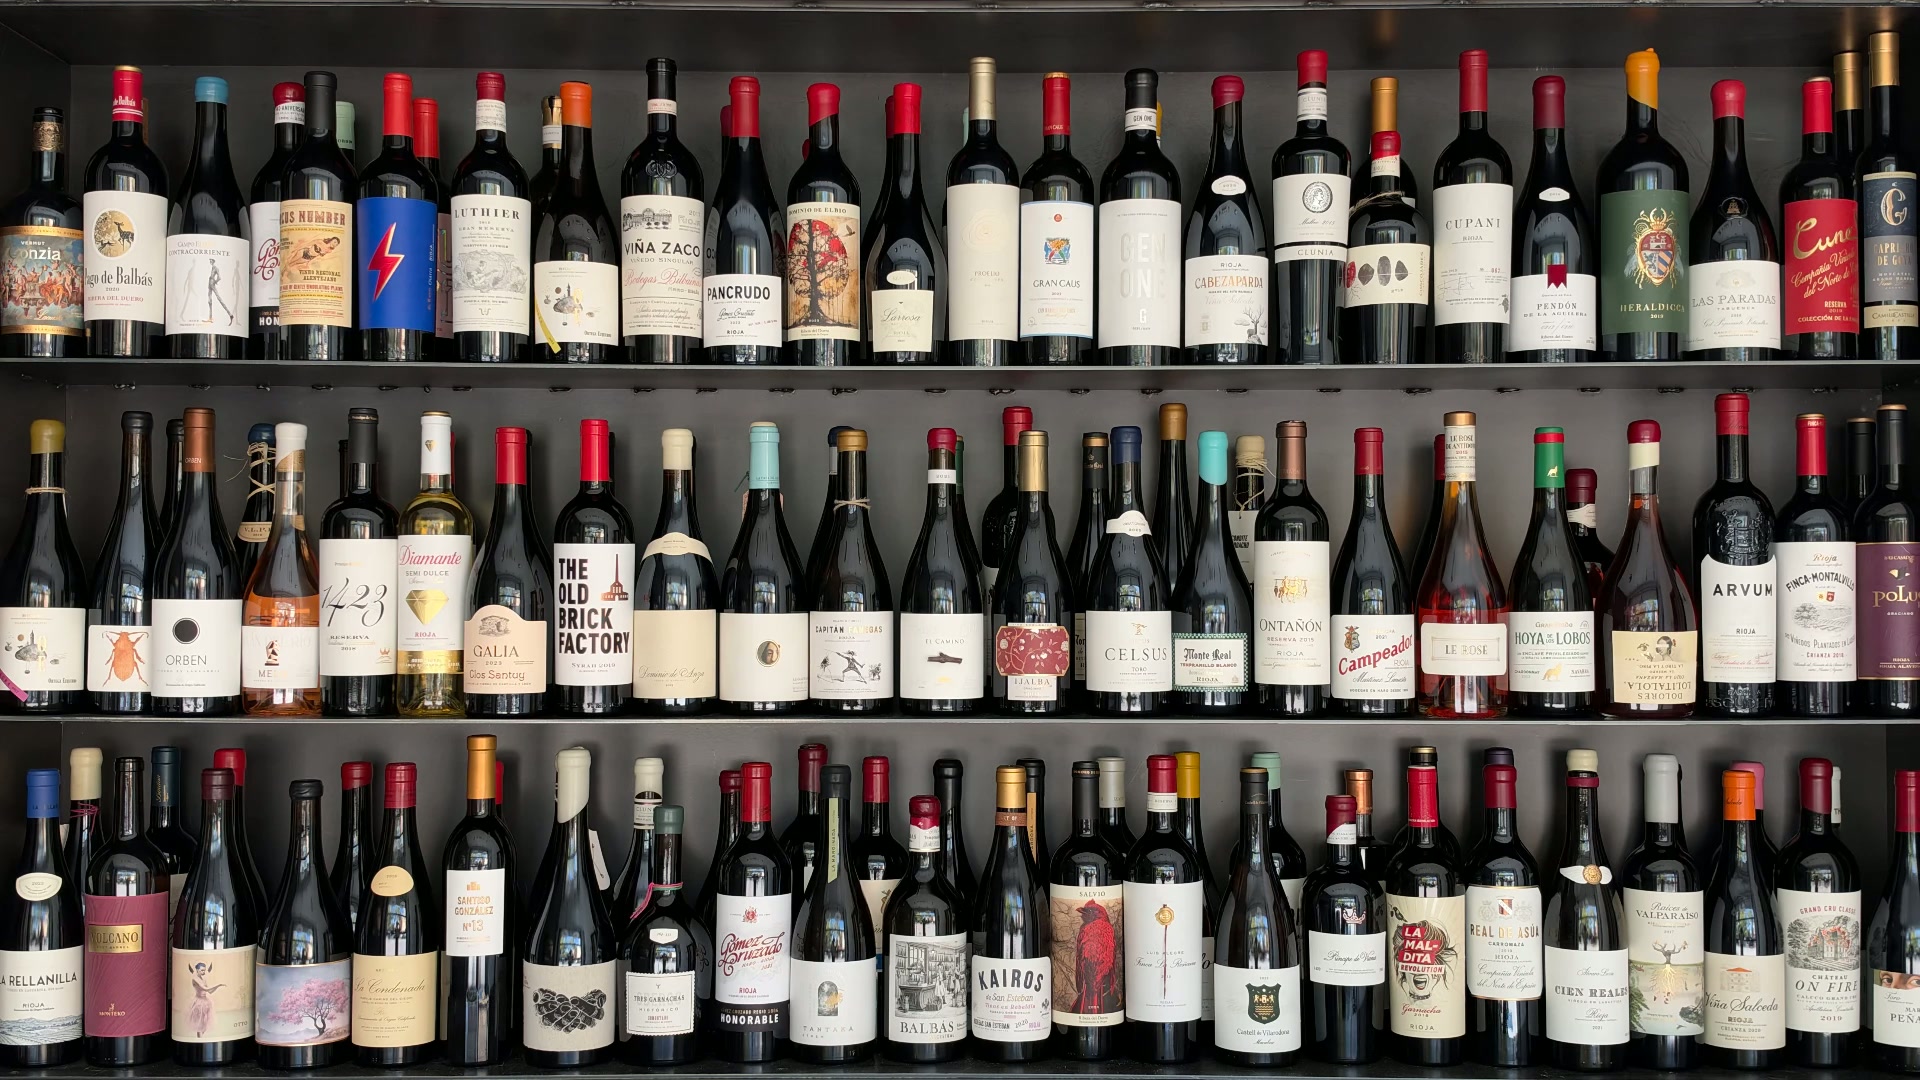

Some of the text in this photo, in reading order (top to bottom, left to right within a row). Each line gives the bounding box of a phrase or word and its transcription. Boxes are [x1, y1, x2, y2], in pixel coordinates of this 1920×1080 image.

[299, 211, 346, 226] NUMBER
[454, 208, 520, 220] LUTHIER
[789, 208, 811, 216] DOMINIO
[1445, 218, 1501, 230] CUPANI
[1793, 217, 1853, 259] Cune
[624, 238, 701, 257] VIÑA ZACO
[658, 257, 694, 265] SINGULAR
[1877, 256, 1889, 266] DE
[101, 271, 113, 284] de
[116, 267, 153, 286] Balbás
[624, 268, 657, 290] Bodegas
[1791, 263, 1831, 288] Compañía
[1033, 279, 1081, 288] GRAN CAUS
[1195, 276, 1264, 289] CABEZAPARDA
[1803, 274, 1843, 299] del Norte
[708, 286, 770, 301] PANCRUDO
[1537, 301, 1577, 310] PENDÓN
[1692, 294, 1776, 308] LAS PARADAS
[881, 307, 921, 323] Larrosa
[1620, 303, 1685, 314] HERALDICCA
[1798, 315, 1833, 323] COLECCIÓN
[399, 544, 462, 566] Diamante
[1813, 552, 1837, 563] Rioja
[558, 558, 588, 580] THE
[1786, 571, 1854, 592] FINCA-MONTALVILLO
[559, 583, 588, 605] OLD
[1713, 583, 1773, 597] ARVUM
[321, 577, 388, 628] 1423
[559, 608, 613, 629] BRICK
[1259, 618, 1322, 632] ONTAÑÓN
[816, 625, 844, 634] CAPITÁN
[558, 632, 630, 654] FACTORY
[1514, 632, 1545, 645] HOYA
[1556, 632, 1591, 645] LOBOS
[1790, 635, 1841, 649] VIÑEDOS PLANTADOS
[473, 645, 519, 658] GALIA
[1105, 647, 1168, 662] CELSUS
[1184, 648, 1232, 661] Monte Real
[1338, 634, 1413, 676] Campeador
[1445, 645, 1457, 655] LE
[165, 655, 207, 666] ORBEN
[469, 669, 525, 682] Clos Santuy
[1637, 692, 1683, 700] DOLORES
[454, 905, 494, 916] GONZÁLEZ
[1635, 910, 1698, 921] VALPARAÍSO
[1800, 907, 1822, 915] GRAND
[89, 932, 139, 943] VOLCANO
[1405, 928, 1422, 938] LA
[1470, 924, 1540, 938] REAL DE ASÚA
[720, 933, 763, 955] Gómez
[1405, 940, 1439, 951] MAL-
[1401, 953, 1432, 964] DITA
[1400, 965, 1444, 973] REVOLUTION
[1477, 964, 1512, 977] Compañía
[10, 973, 77, 987] RELLANILLA
[369, 979, 426, 994] Condenada
[978, 968, 1044, 993] KAIROS
[1476, 977, 1484, 988] del
[1485, 978, 1506, 989] Norte
[1795, 980, 1857, 992] ON FIRE
[992, 993, 1005, 1002] San
[1006, 993, 1033, 1002] Esteban
[1554, 986, 1628, 998] CIEN REALES
[1705, 992, 1778, 1012] Viña Salceda
[1401, 1004, 1441, 1015] Garnacha
[1585, 1008, 1609, 1020] Rioja
[720, 1013, 779, 1024] HONORABLE
[900, 1019, 954, 1034] BALBÁS
